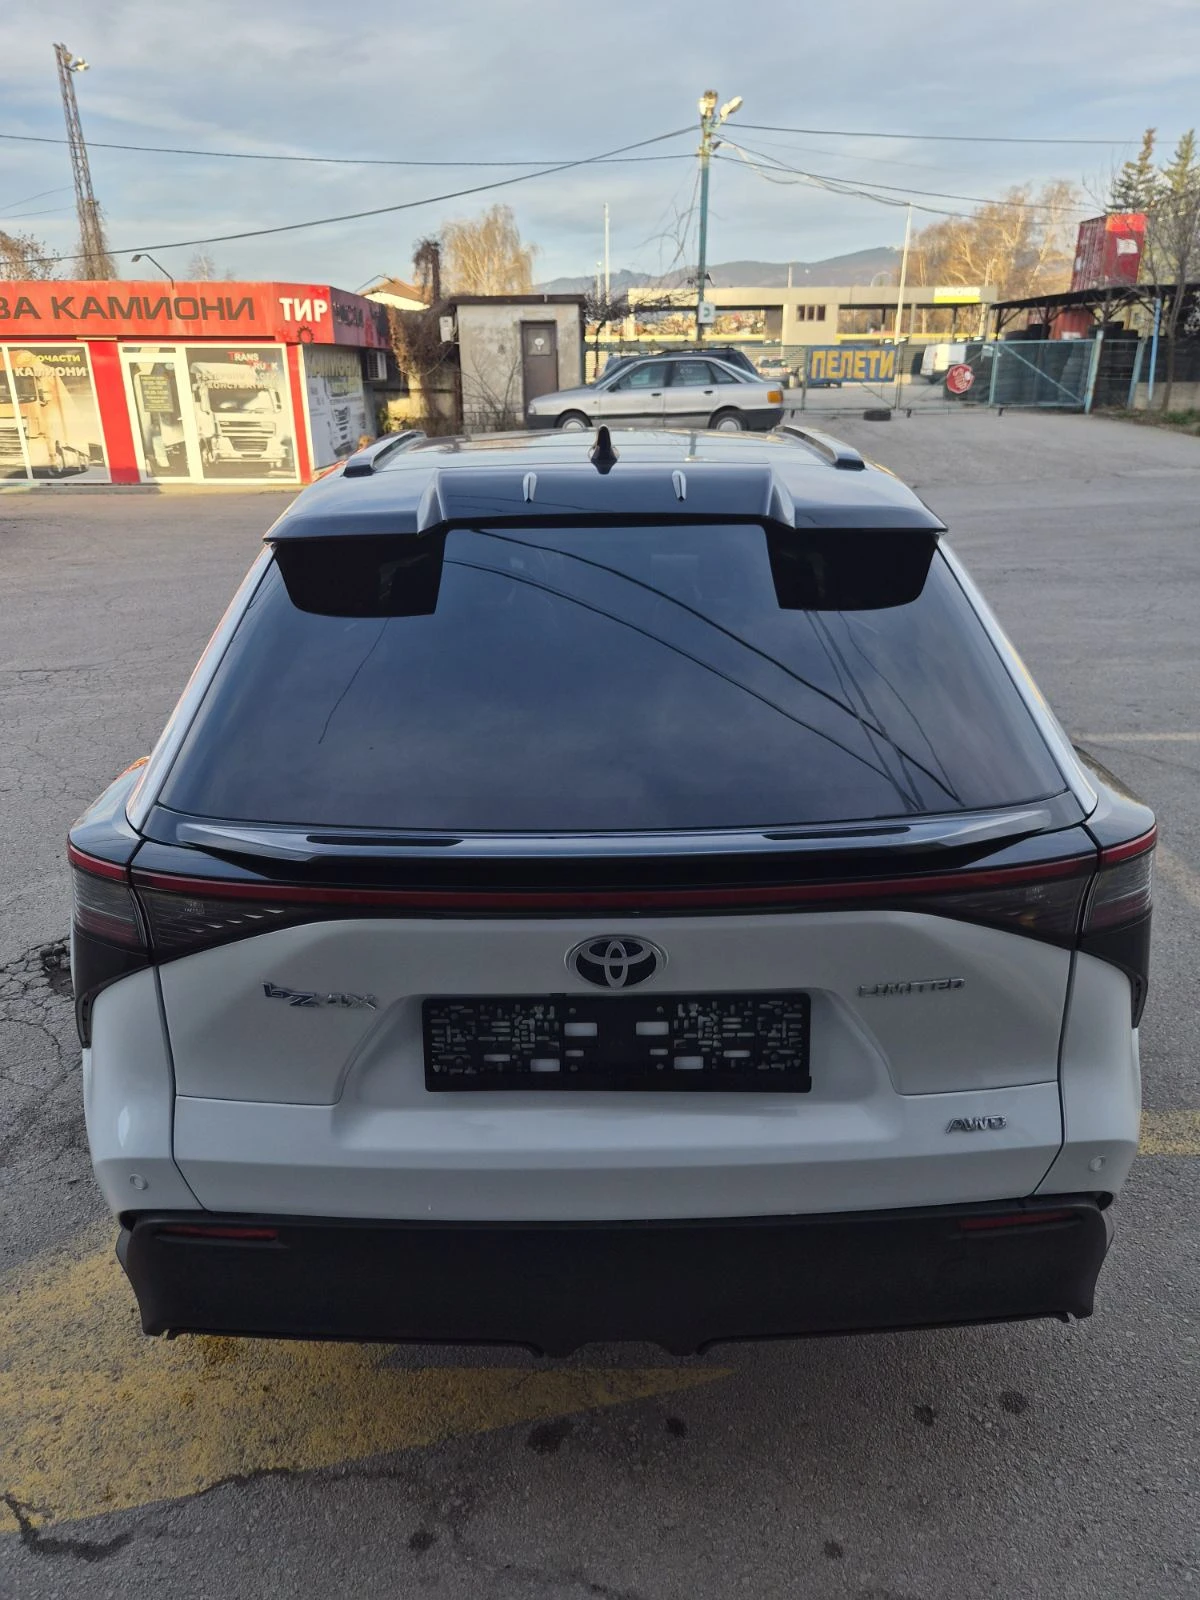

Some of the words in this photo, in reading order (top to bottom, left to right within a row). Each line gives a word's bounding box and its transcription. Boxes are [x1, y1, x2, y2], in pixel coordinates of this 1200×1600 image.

[50, 296, 255, 320] КАМИОНИ
[279, 297, 328, 323] ТИР
[811, 350, 895, 379] ПЕЛЕТИ
[945, 1114, 1007, 1132] AWD
